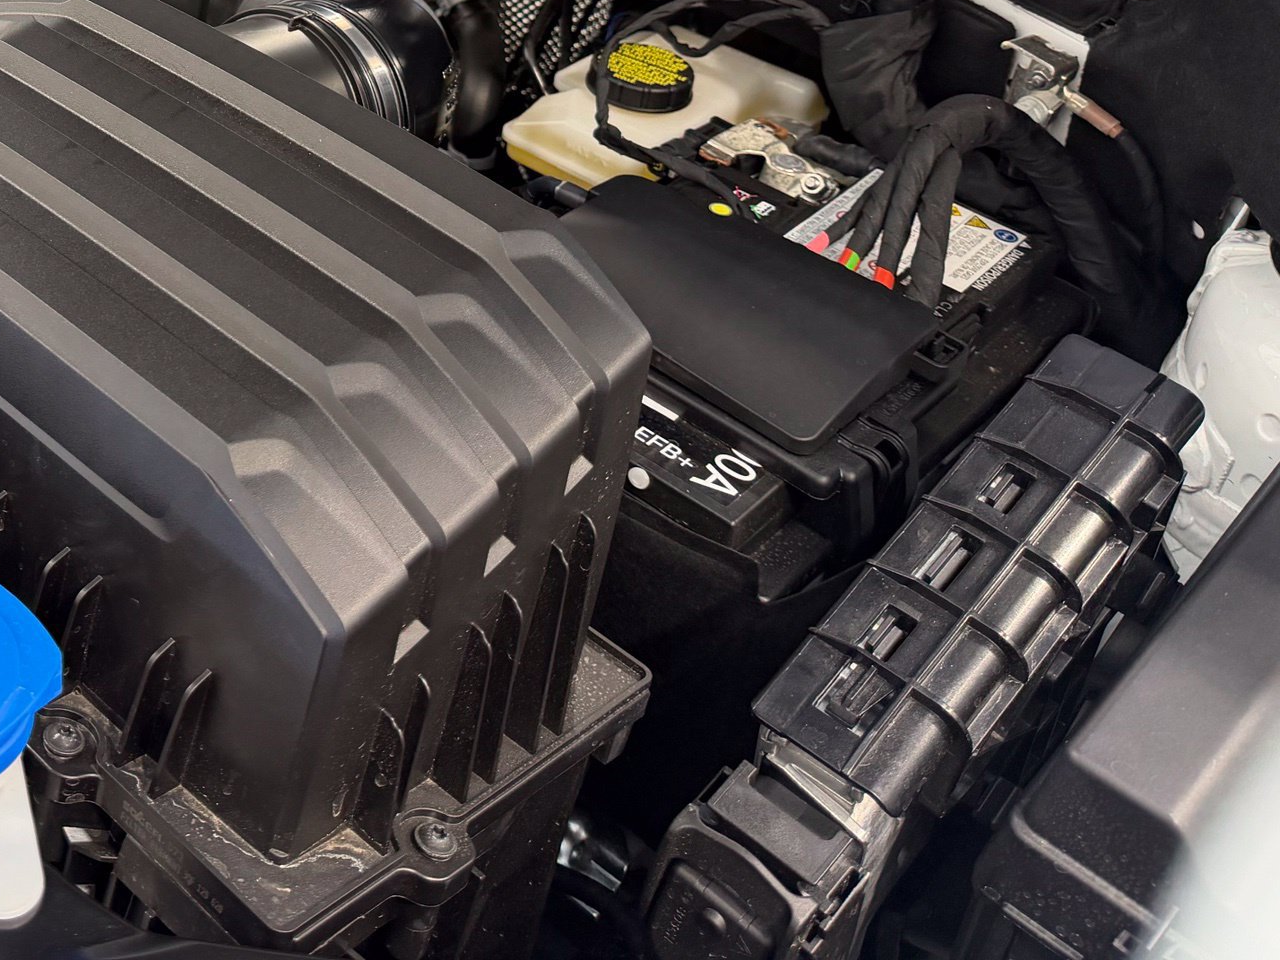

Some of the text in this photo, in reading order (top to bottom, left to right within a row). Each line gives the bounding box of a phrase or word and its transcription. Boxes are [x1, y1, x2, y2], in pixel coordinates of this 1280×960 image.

[972, 249, 1025, 291] DANGER/POISON
[634, 426, 695, 468] EFB+
[689, 447, 763, 496] 0A
